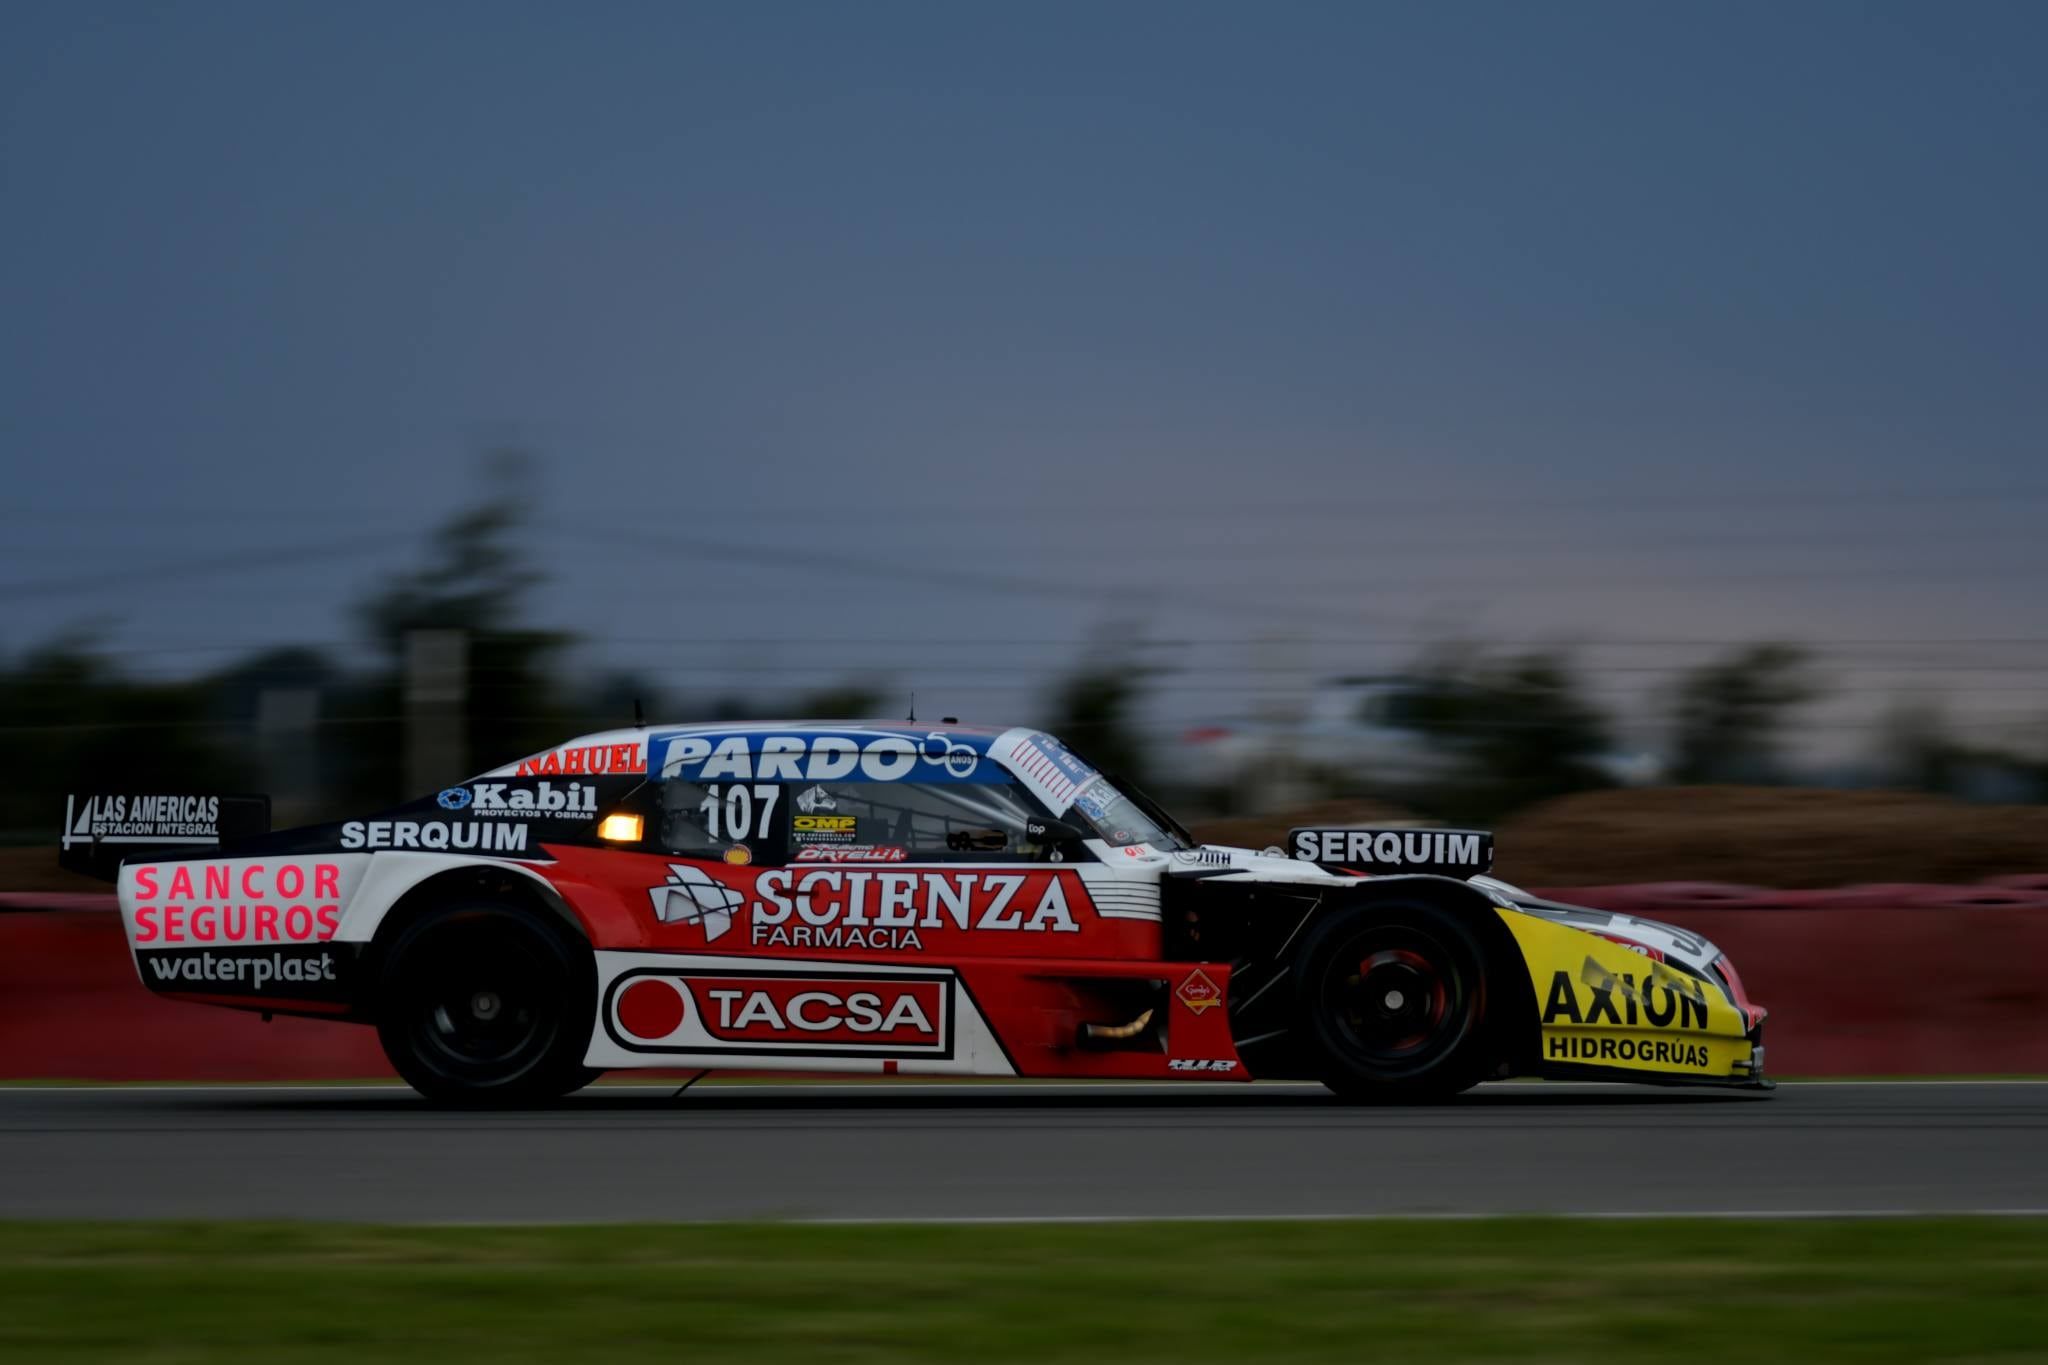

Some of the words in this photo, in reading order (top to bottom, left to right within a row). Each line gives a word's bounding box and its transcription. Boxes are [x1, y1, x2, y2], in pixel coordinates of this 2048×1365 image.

[515, 742, 647, 777] NAHUEL
[661, 737, 918, 781] PARDO
[92, 795, 126, 821] LAS
[129, 795, 219, 822] AMERICAS
[470, 781, 598, 811] Kabil
[699, 783, 781, 843] 107
[91, 822, 153, 835] ESTACION
[156, 822, 219, 835] INTEGRAL
[474, 809, 541, 819] PROYECTOS
[544, 810, 553, 818] Y
[554, 811, 594, 820] OBRAS
[793, 818, 856, 828] OMP
[339, 821, 529, 852] SERQUIM
[1295, 831, 1481, 866] SERQUIM
[135, 864, 340, 900] SANCOR
[752, 869, 1081, 933] SCIENZA
[135, 905, 340, 942] SEGUROS
[752, 926, 923, 951] FARMACIA
[149, 952, 337, 990] waterplast
[708, 990, 934, 1034] TACSA
[1542, 968, 1709, 1029] AXION
[1549, 1037, 1709, 1067] HIDROGRÚAS
